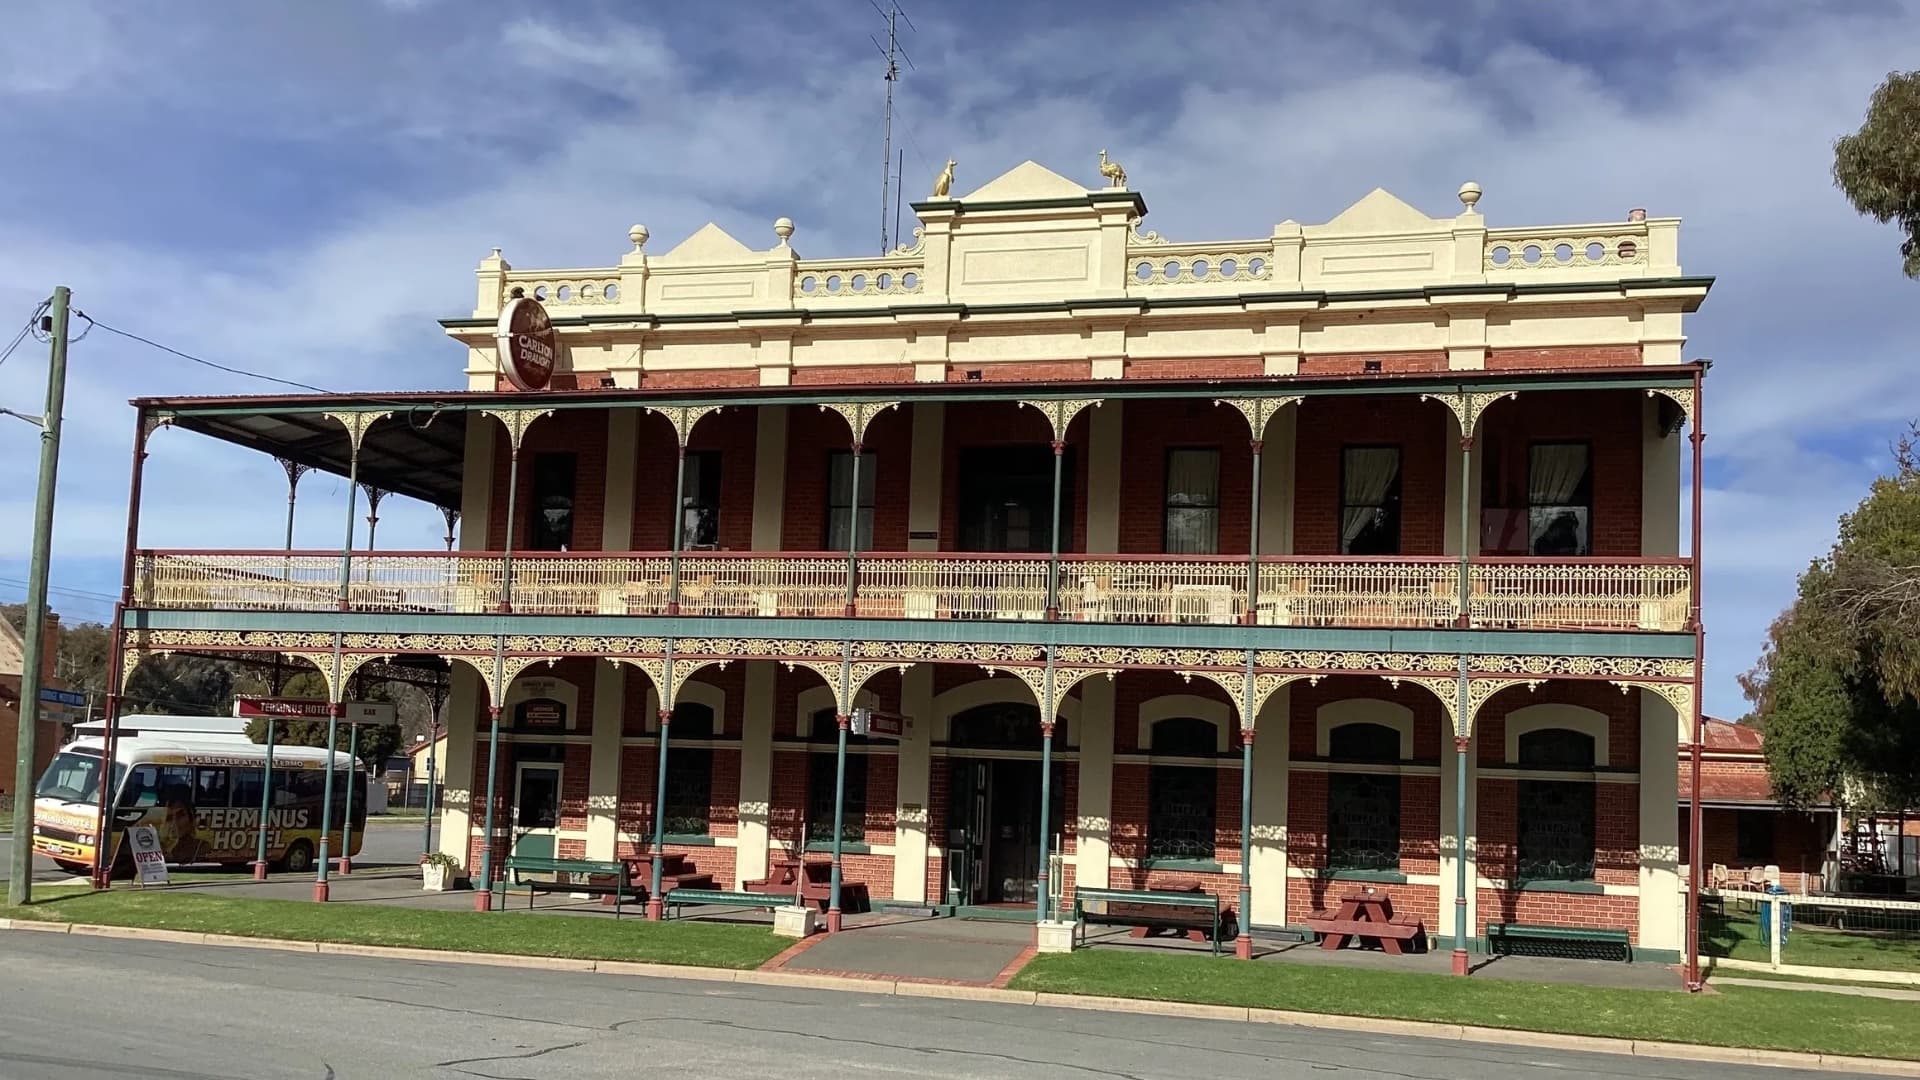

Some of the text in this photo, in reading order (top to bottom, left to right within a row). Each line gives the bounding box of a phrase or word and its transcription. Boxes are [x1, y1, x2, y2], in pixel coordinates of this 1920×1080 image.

[519, 335, 553, 360] CARLTON
[520, 349, 551, 369] DRAUGHT
[260, 702, 330, 715] TERMINUS HOTEL
[204, 756, 240, 766] BETTER
[195, 808, 309, 829] TERMNUS
[213, 830, 285, 850] HOTEL
[136, 851, 163, 864] OPEN
